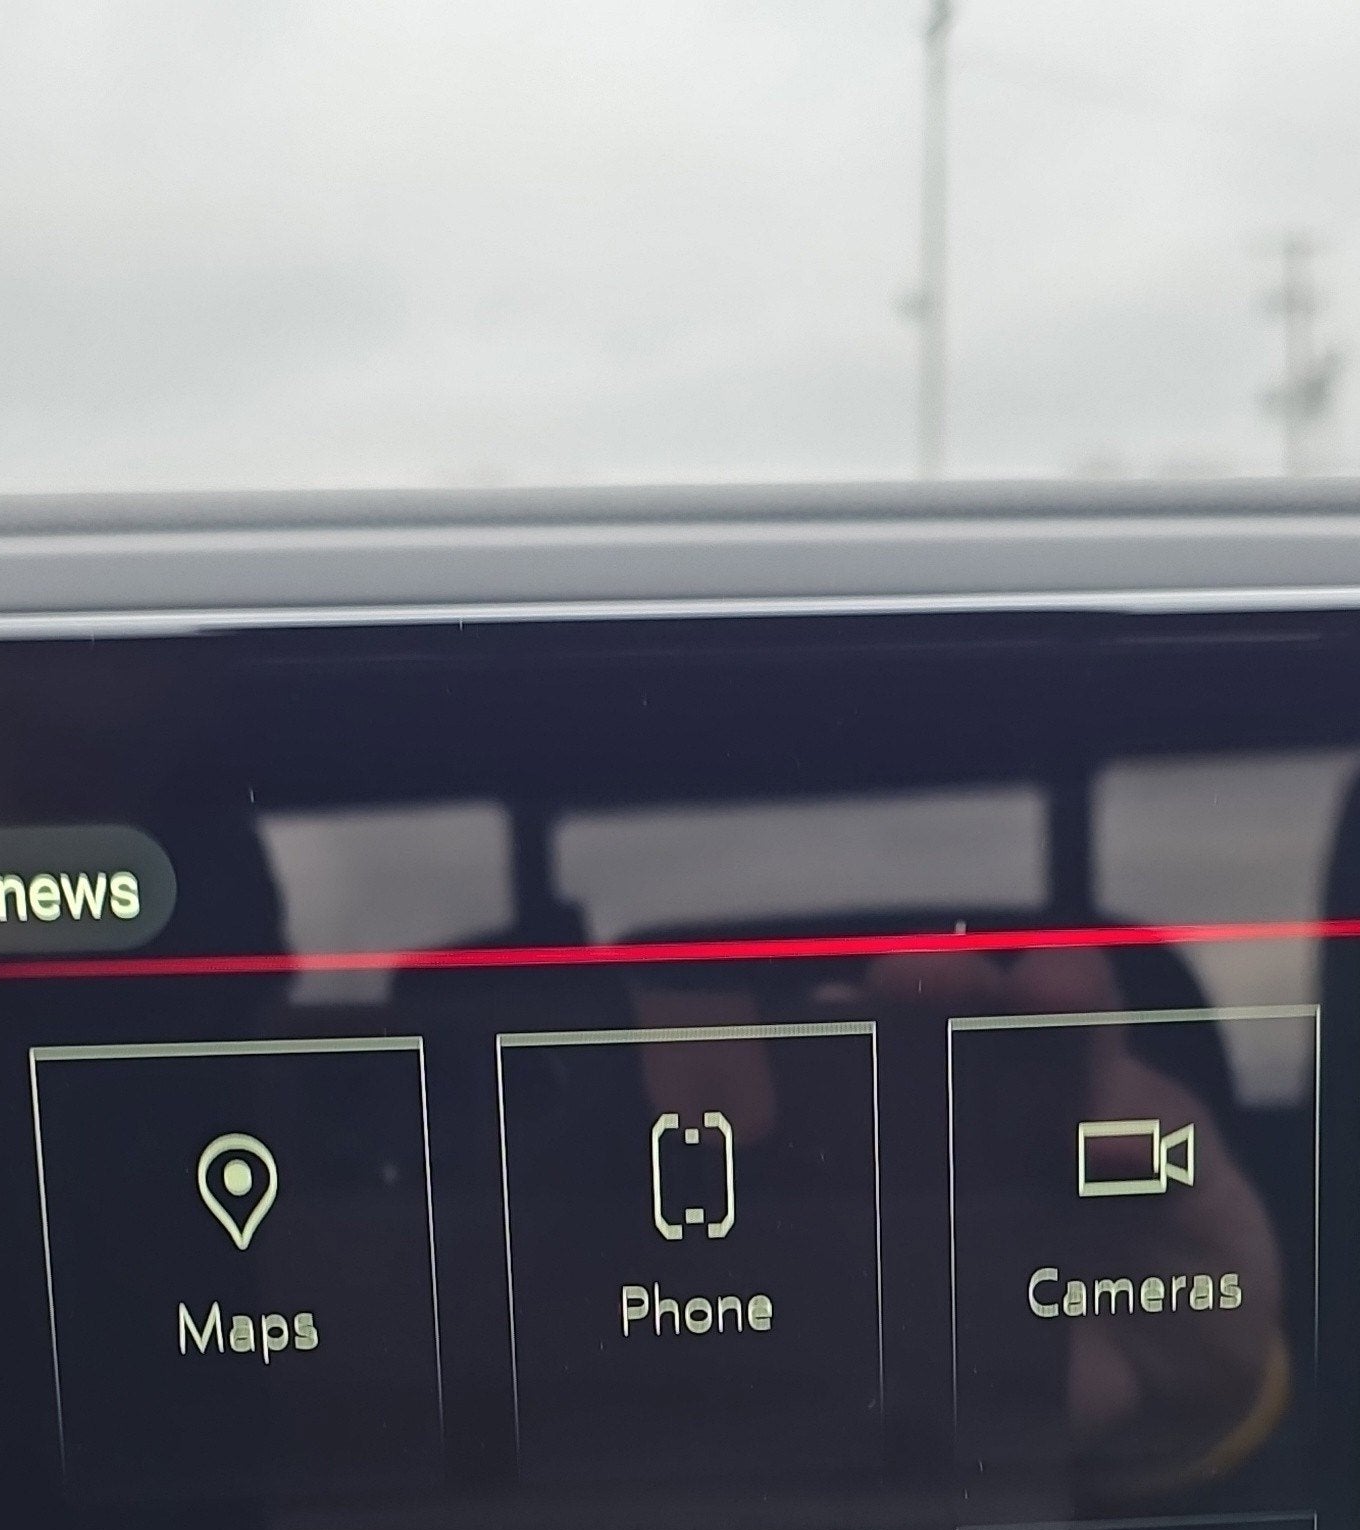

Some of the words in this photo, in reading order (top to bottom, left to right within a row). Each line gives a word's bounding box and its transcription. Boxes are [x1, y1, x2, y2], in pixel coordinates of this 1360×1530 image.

[620, 1283, 773, 1339] Phone
[1027, 1266, 1243, 1319] Cameras
[178, 1301, 320, 1365] Maps
